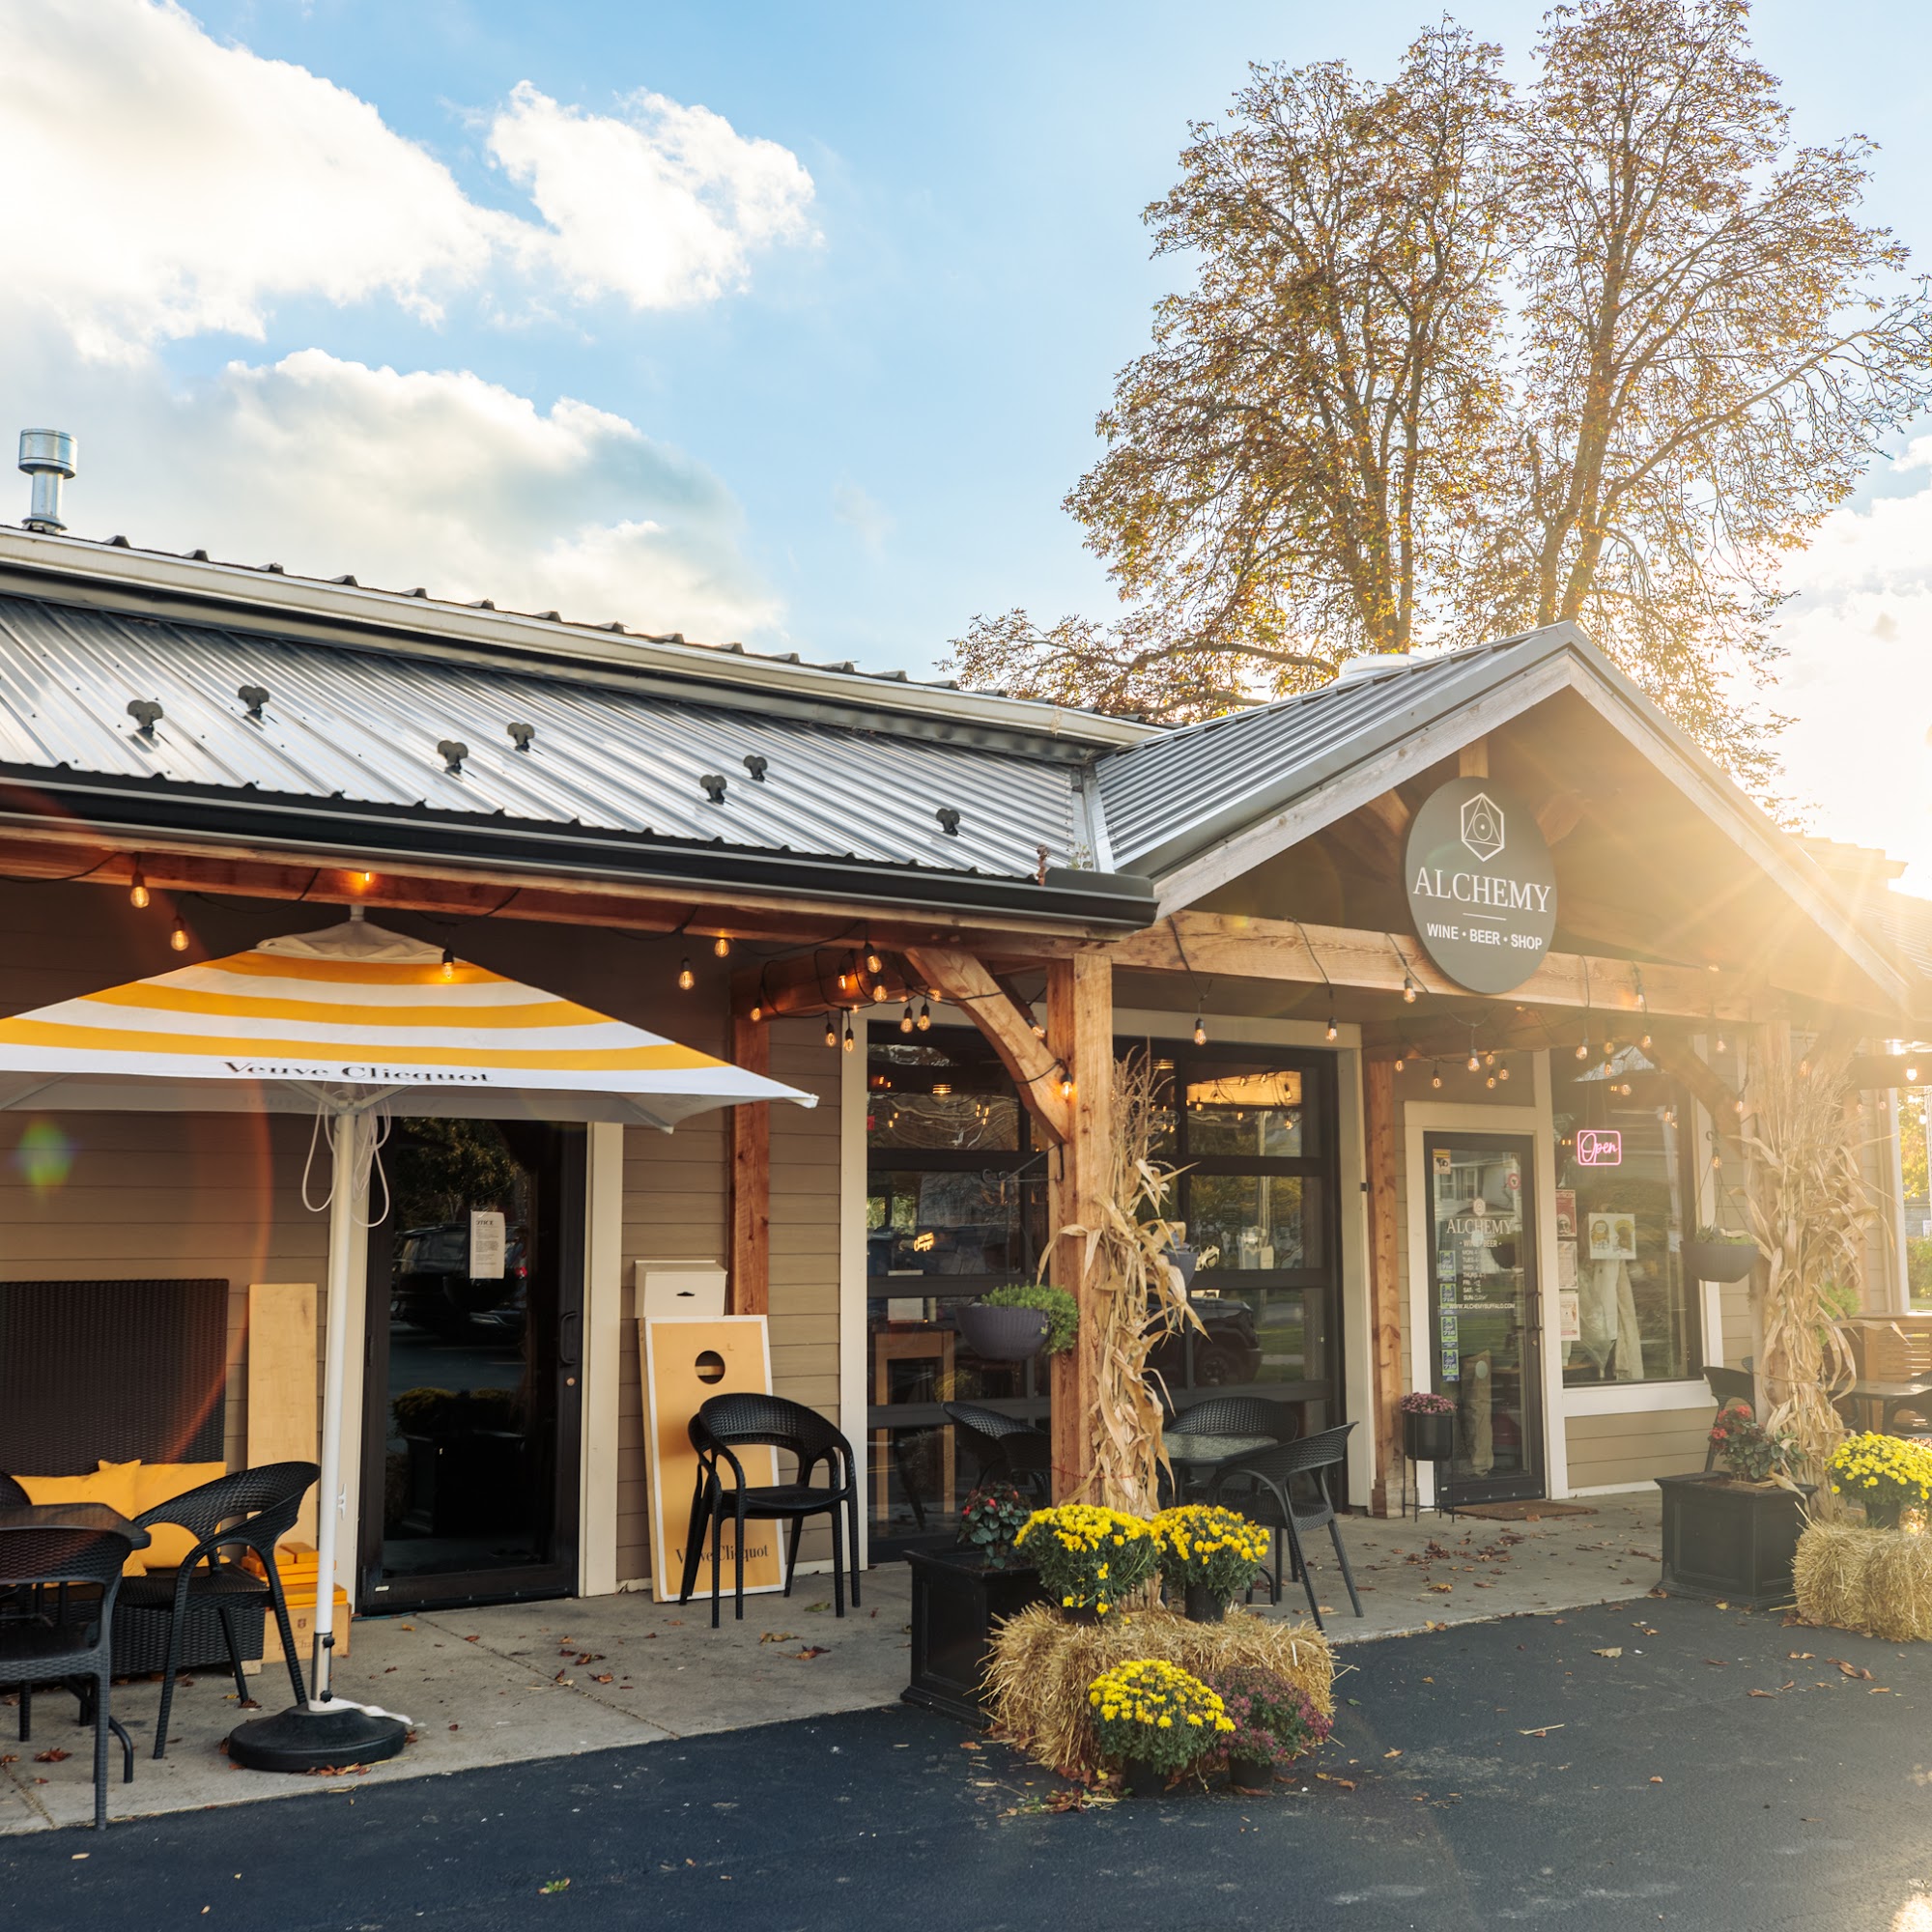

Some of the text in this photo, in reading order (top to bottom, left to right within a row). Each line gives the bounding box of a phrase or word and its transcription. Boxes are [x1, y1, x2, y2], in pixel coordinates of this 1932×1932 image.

[1412, 867, 1551, 913] ALCHEMY
[1427, 923, 1543, 950] WINE BEER SHOP
[223, 1061, 494, 1083] Veuve Clicquot
[1580, 1132, 1619, 1164] Open
[1446, 1218, 1514, 1235] ALCHEMY
[1483, 1239, 1498, 1248] BEER
[675, 1548, 713, 1564] Vve
